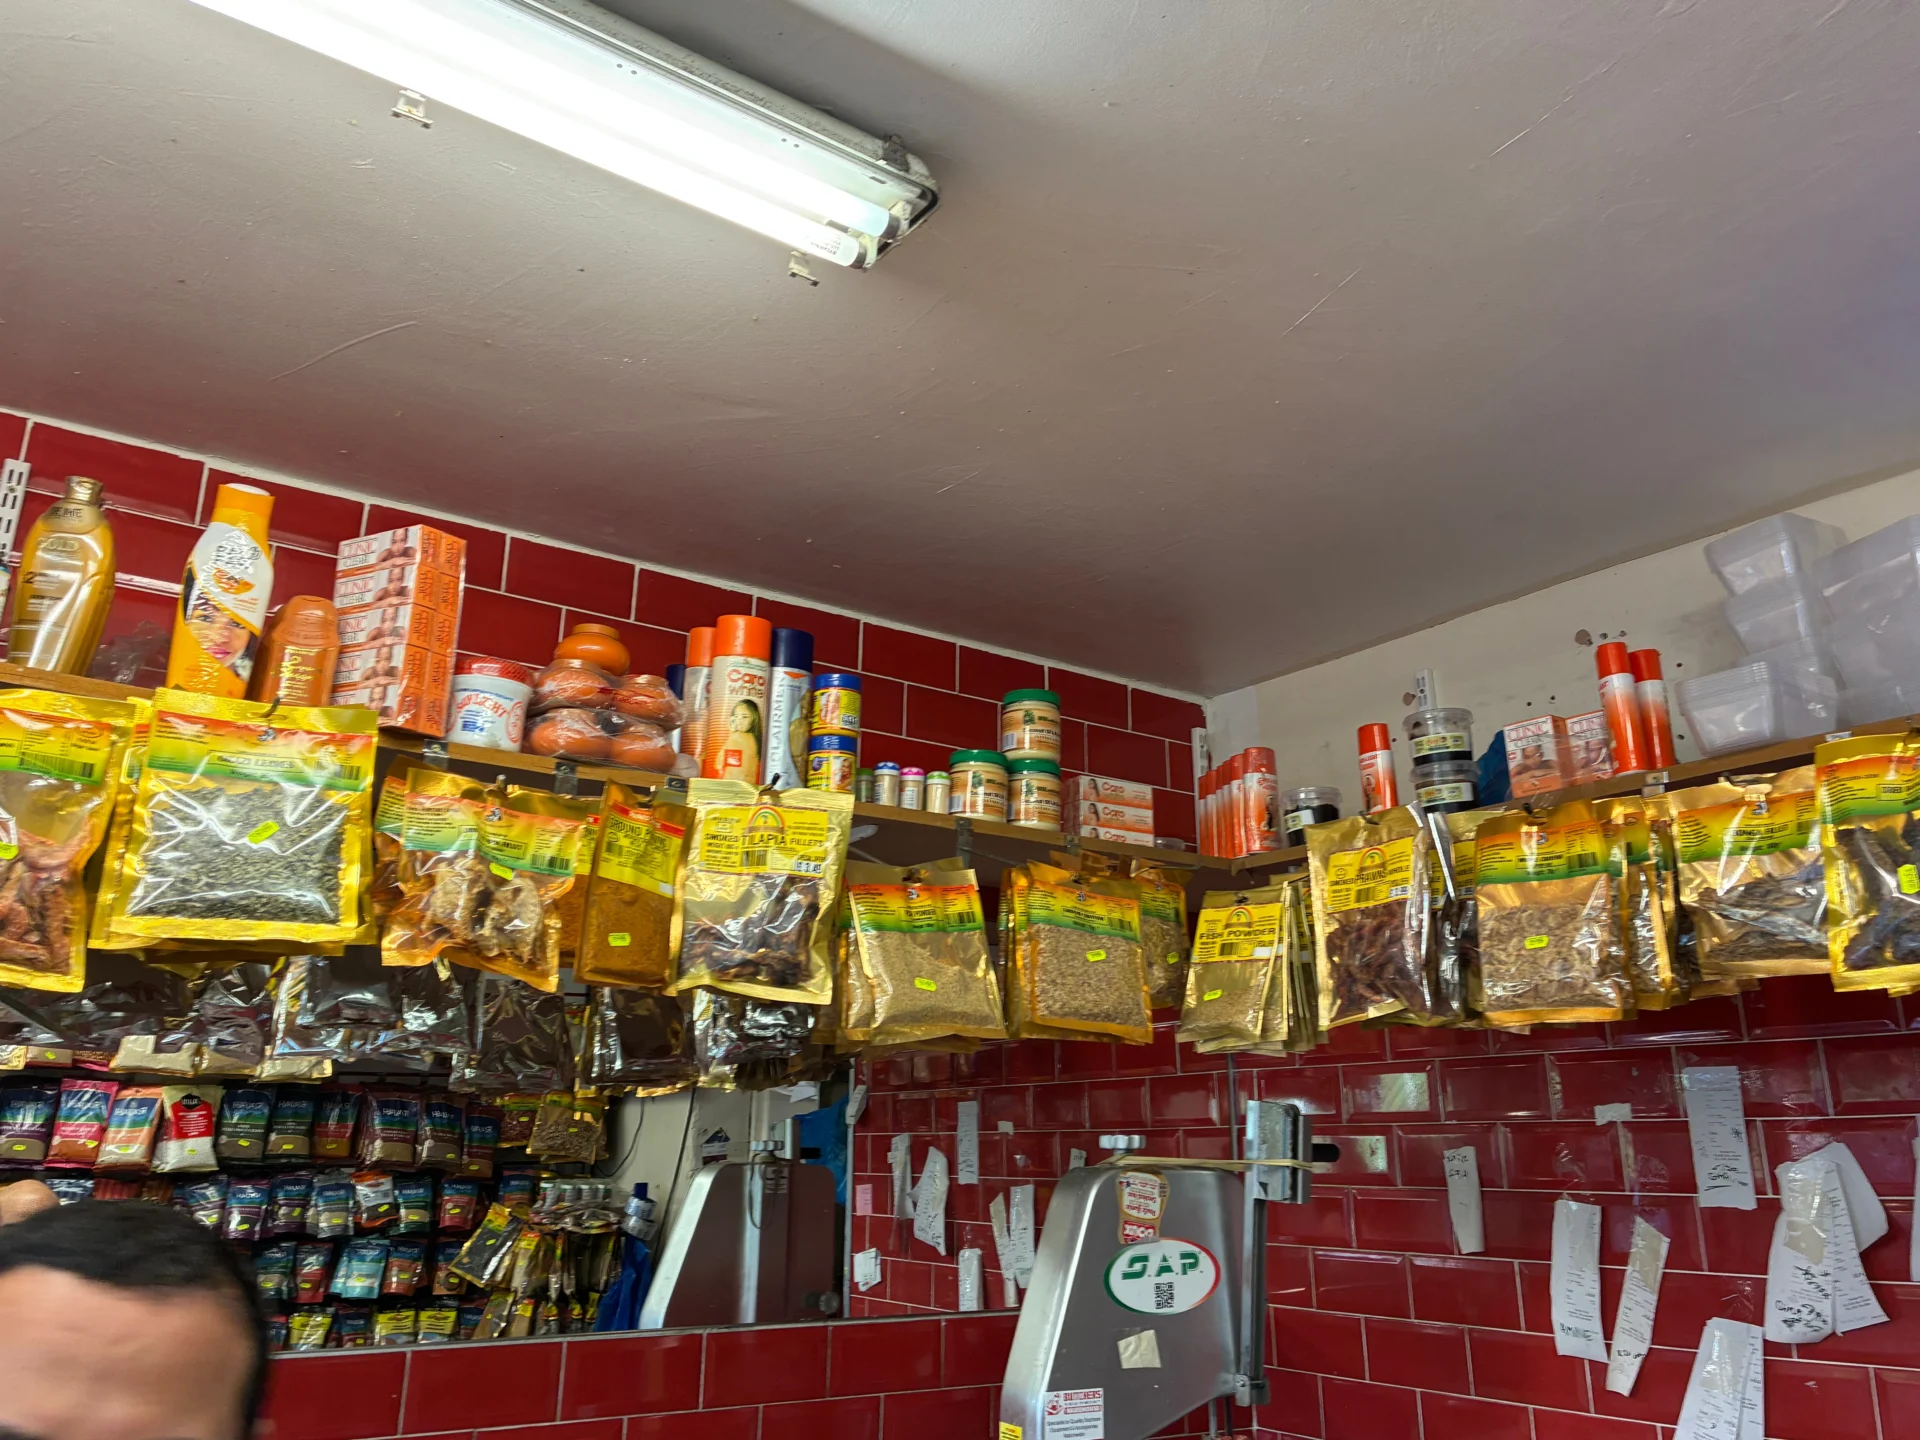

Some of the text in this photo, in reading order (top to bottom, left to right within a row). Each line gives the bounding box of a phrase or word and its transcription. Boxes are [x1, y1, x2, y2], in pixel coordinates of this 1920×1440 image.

[340, 540, 373, 558] CLINIC
[728, 669, 766, 687] Caro
[1508, 725, 1547, 742] CLINIC
[1199, 927, 1277, 940] FISH POWDER
